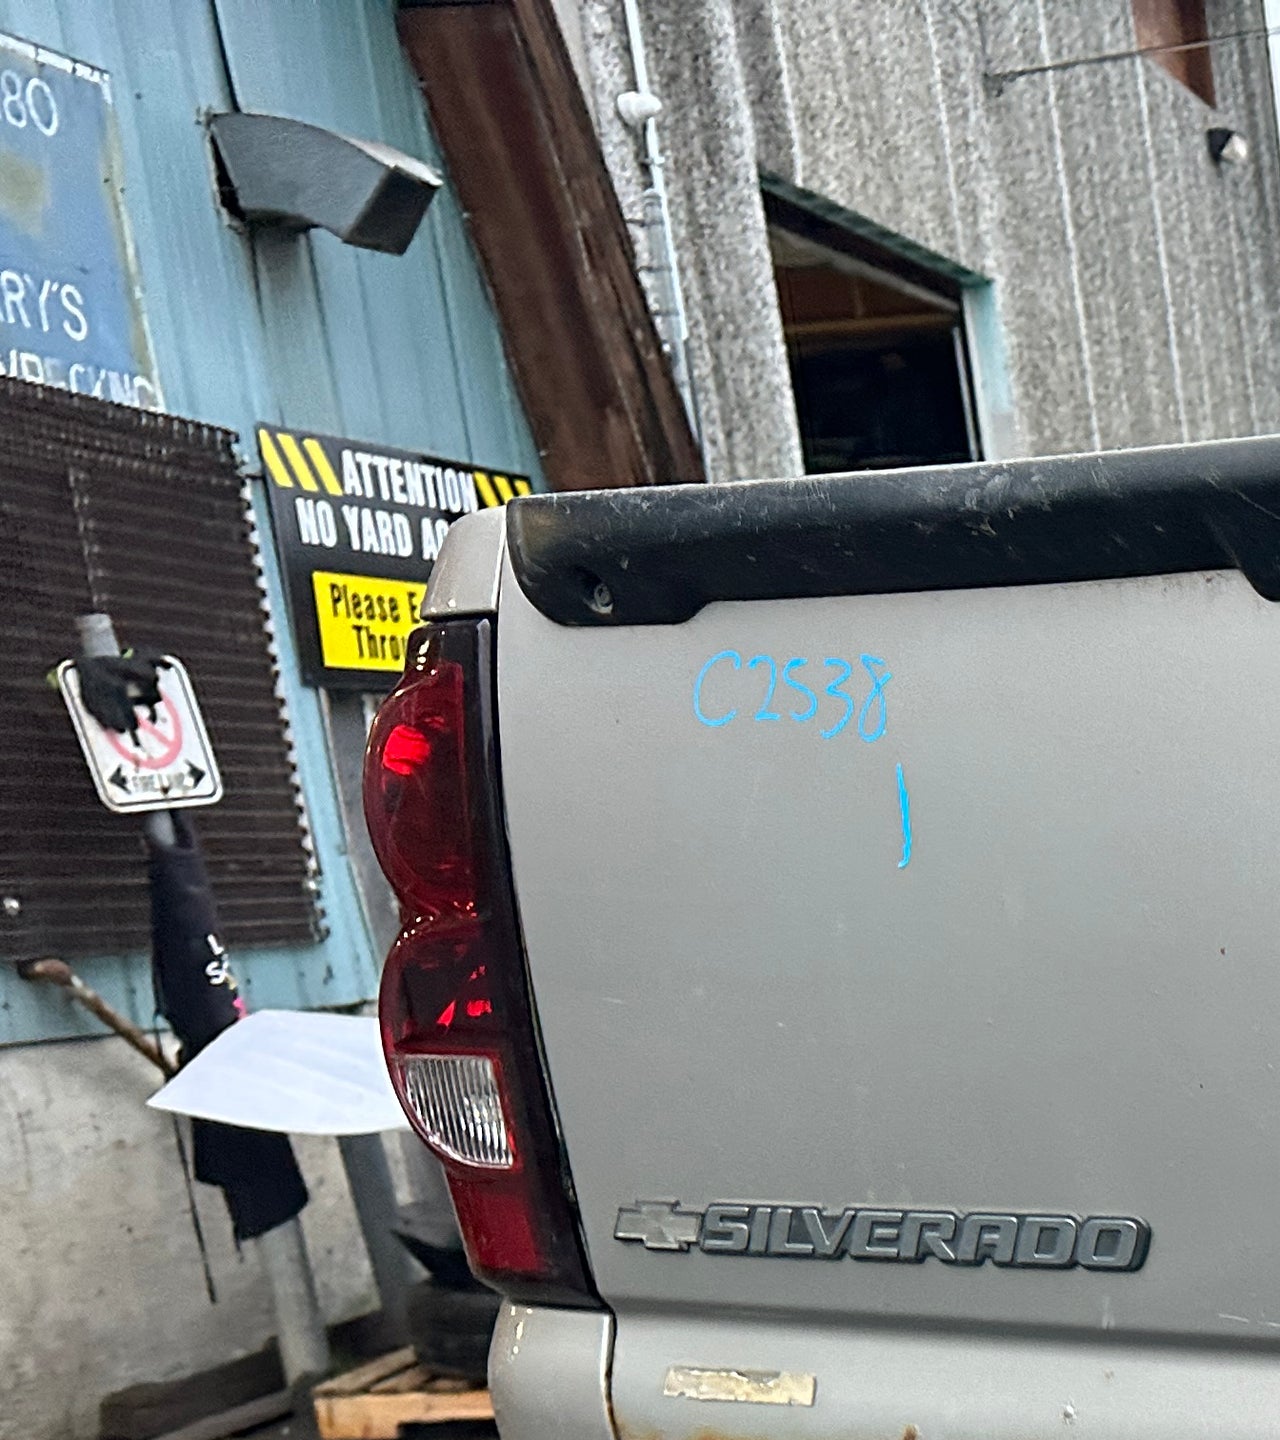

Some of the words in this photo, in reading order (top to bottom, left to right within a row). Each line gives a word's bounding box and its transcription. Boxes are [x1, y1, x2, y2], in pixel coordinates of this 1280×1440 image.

[0, 270, 87, 341] RY'S
[341, 449, 478, 513] ATTENTION
[295, 497, 337, 548] NO
[341, 505, 413, 558] YARD
[330, 583, 400, 623] Please
[694, 650, 891, 742] C2538
[702, 1203, 1151, 1272] SILVERADO
